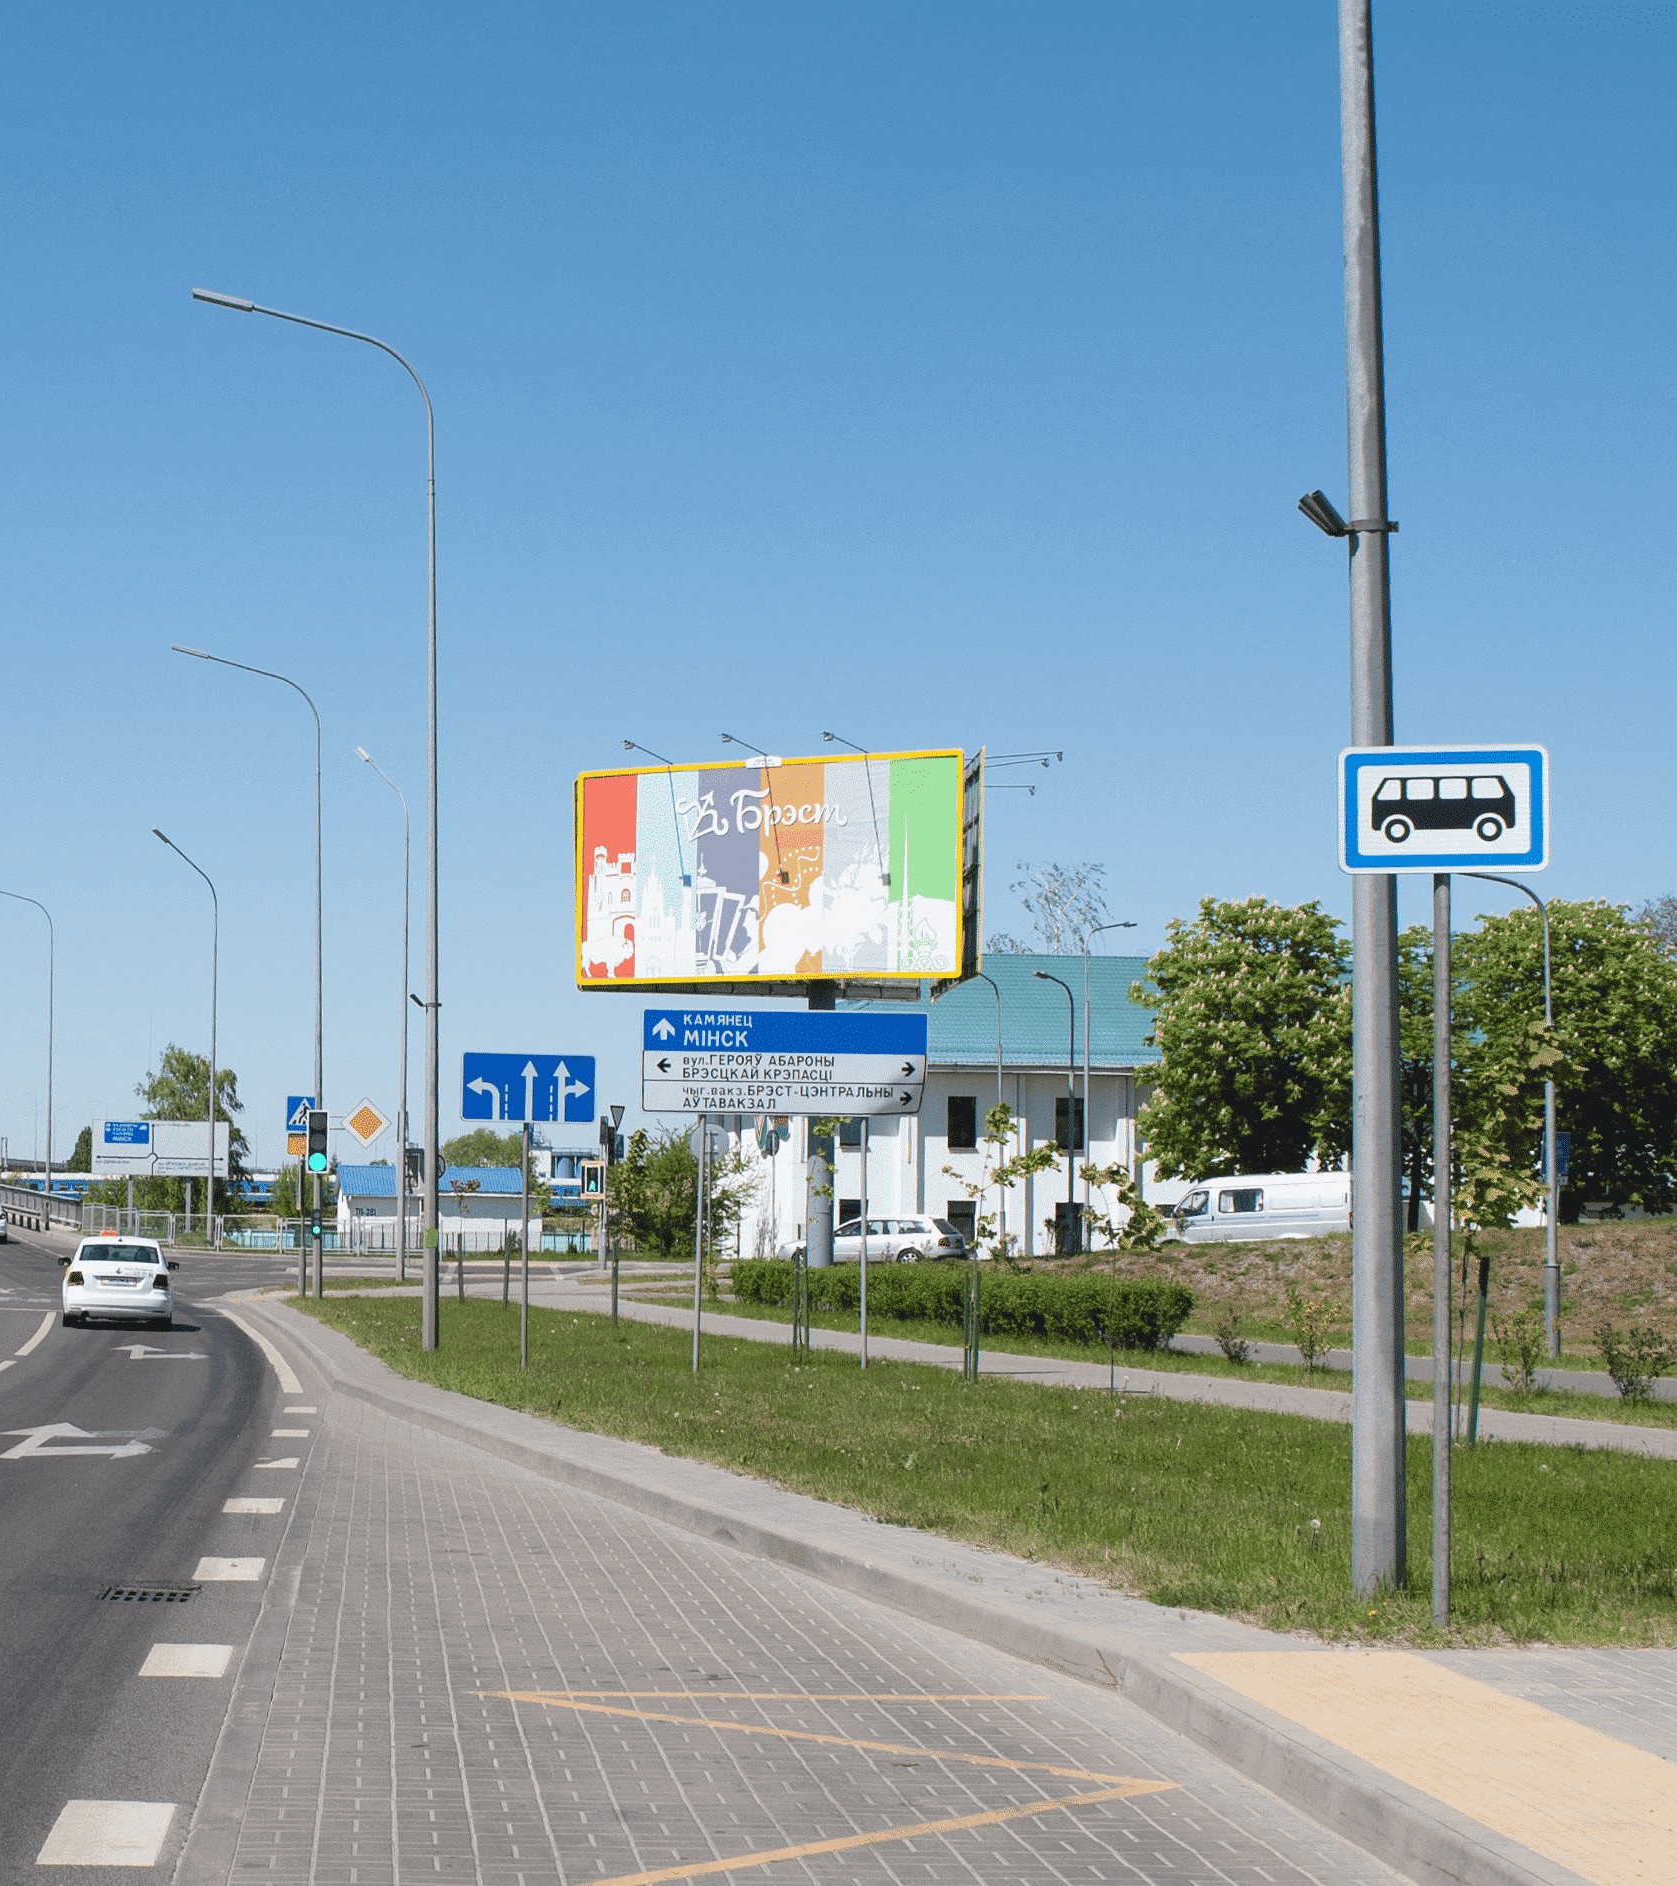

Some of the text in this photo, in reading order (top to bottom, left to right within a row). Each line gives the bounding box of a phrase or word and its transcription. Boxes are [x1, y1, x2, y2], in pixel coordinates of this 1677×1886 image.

[730, 788, 848, 838] Брэст
[683, 1013, 753, 1029] КАМЯНЕЦ
[683, 1029, 749, 1048] МІНСК
[768, 1055, 835, 1068] АБАРОНЫ
[682, 1065, 833, 1083] БРЭСЦКАЙ КРЭПАСЦІ
[682, 1094, 776, 1110] АЎТАВАКЗАЛ
